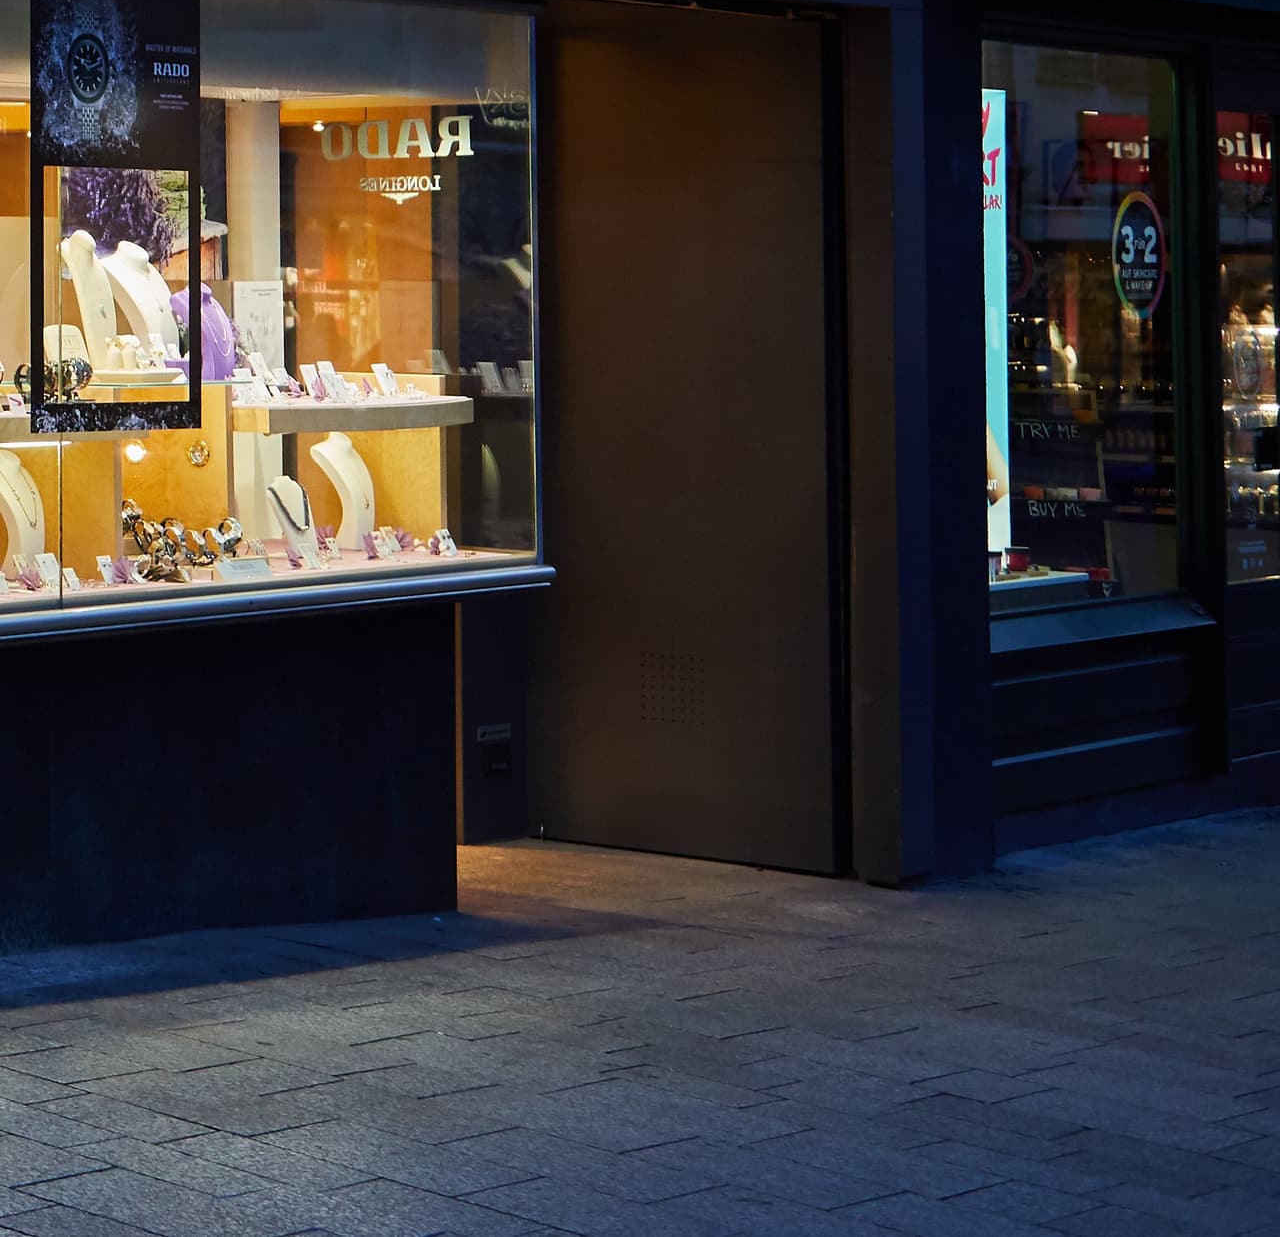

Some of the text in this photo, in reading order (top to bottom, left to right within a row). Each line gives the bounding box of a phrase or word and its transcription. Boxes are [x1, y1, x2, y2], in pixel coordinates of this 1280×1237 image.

[153, 61, 190, 78] RADO
[1120, 224, 1135, 265] 3
[1143, 224, 1159, 265] 2
[1056, 422, 1081, 441] ME
[1027, 499, 1057, 519] BUY
